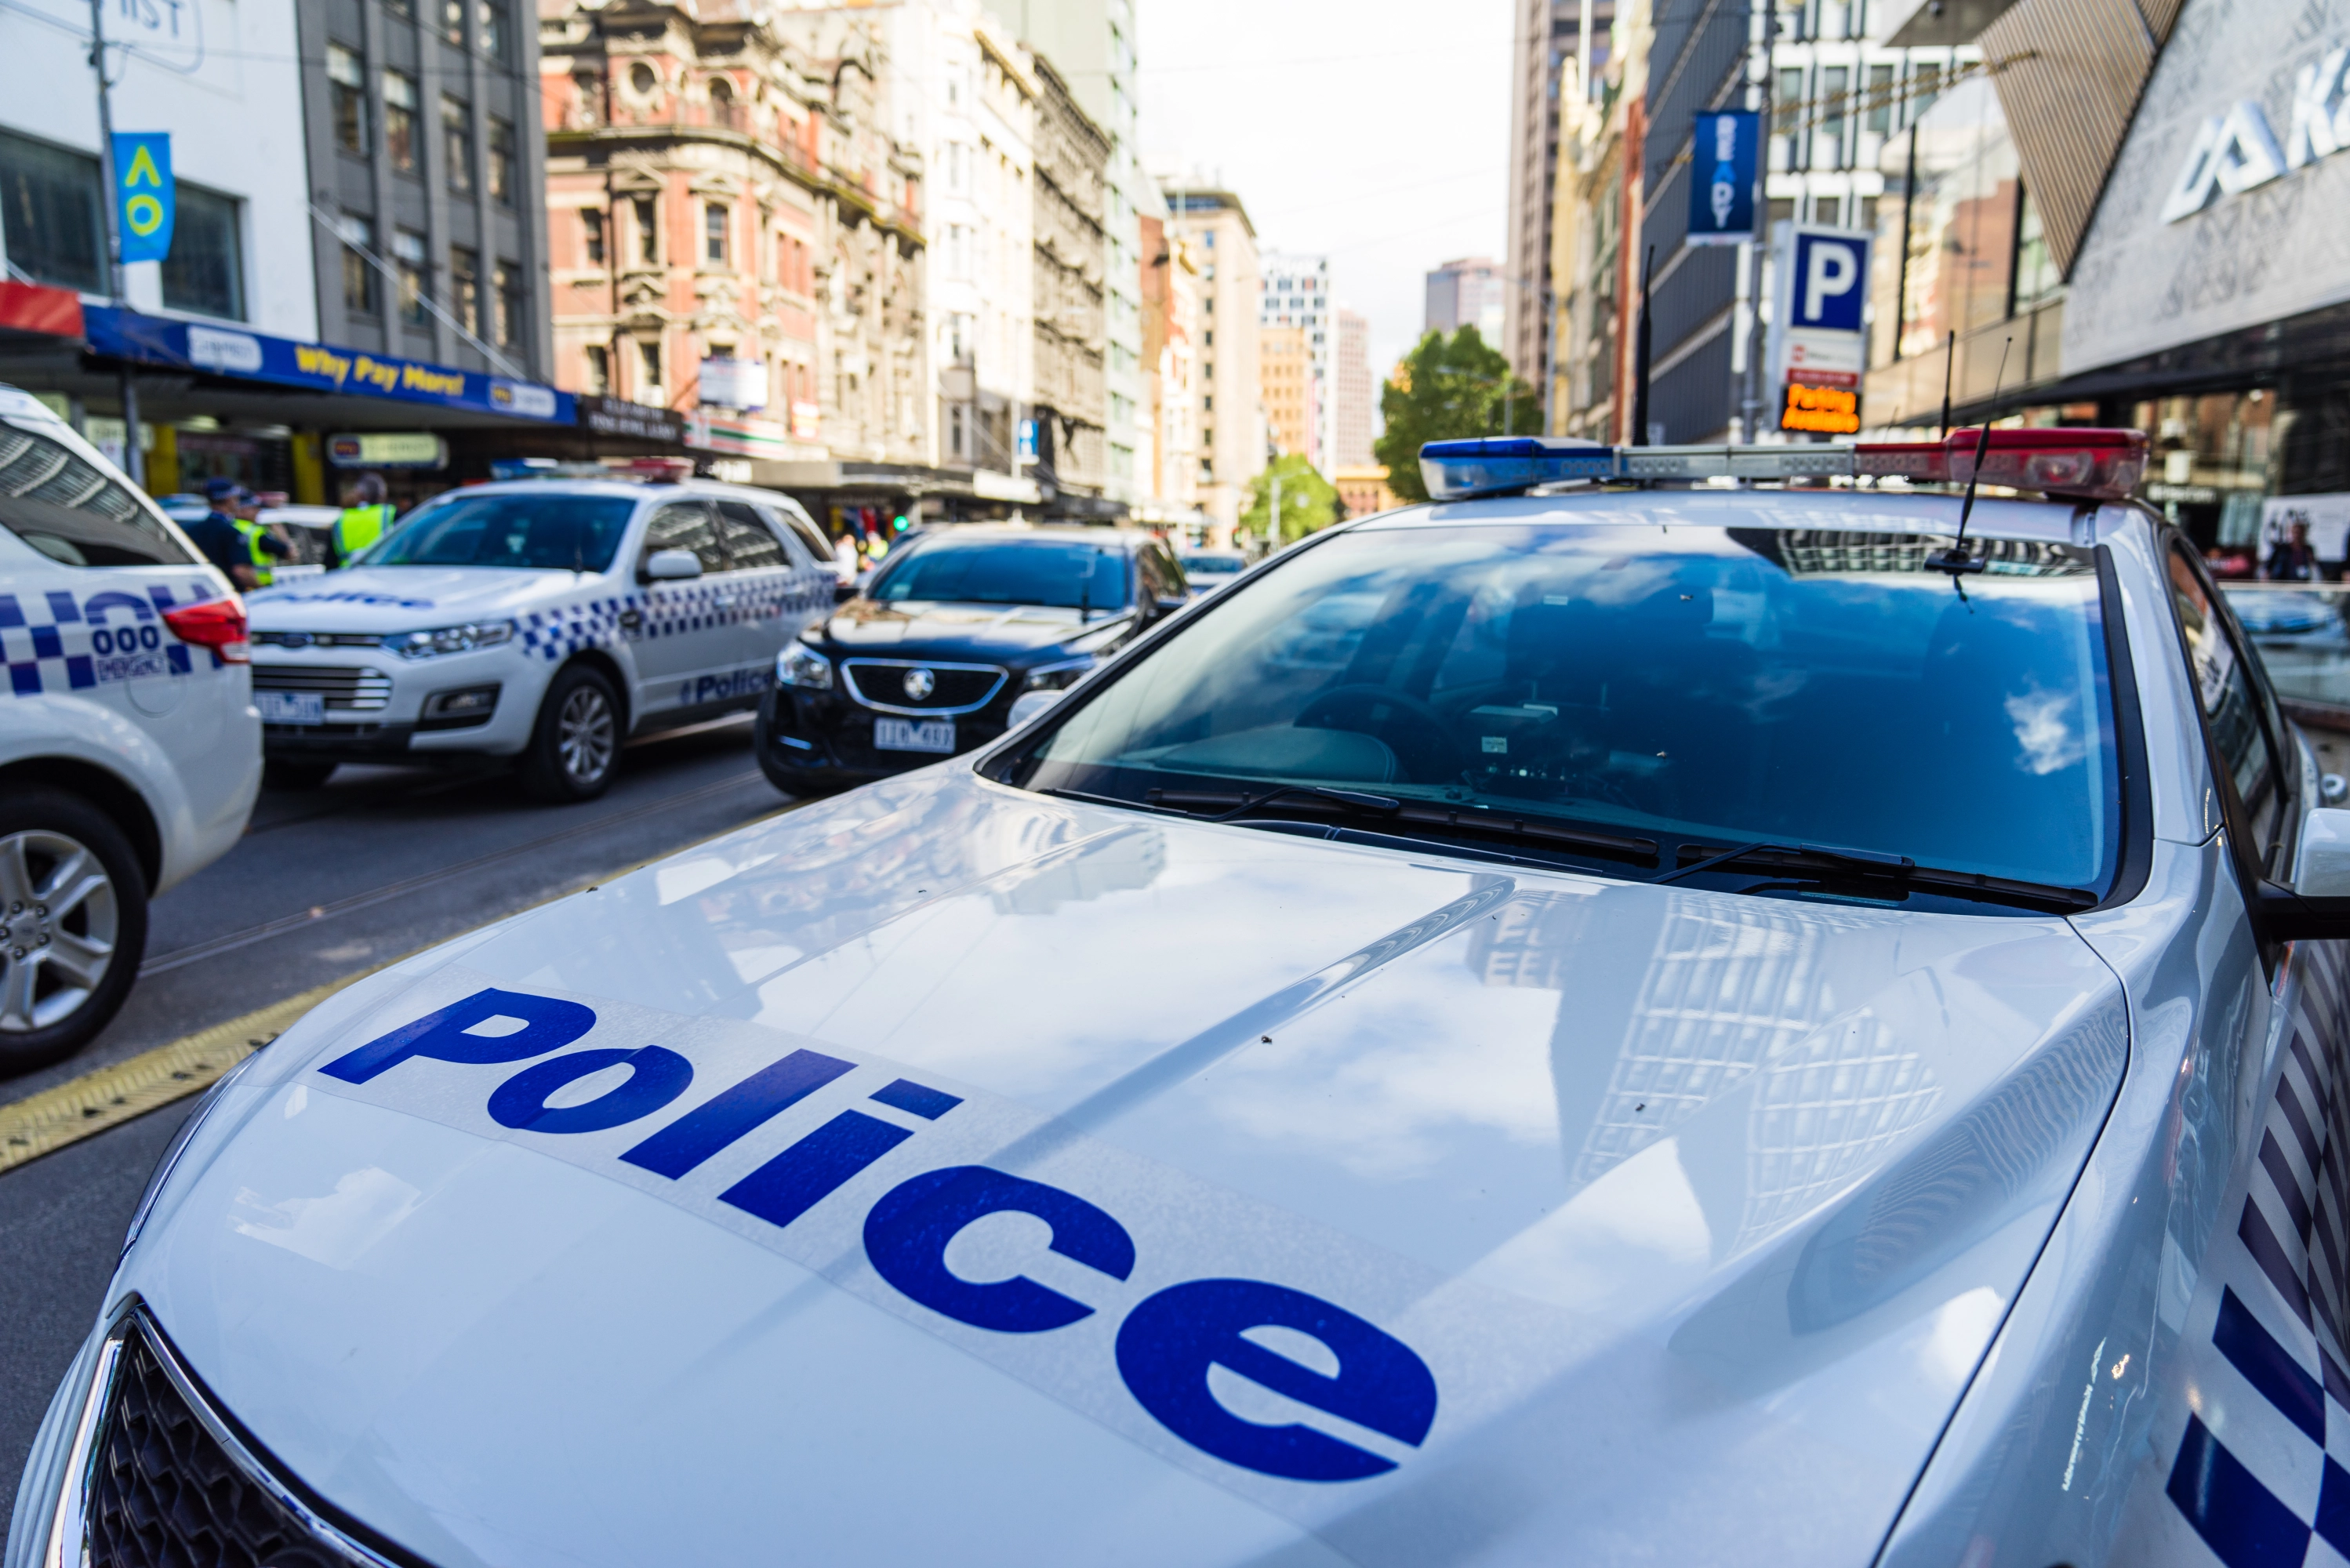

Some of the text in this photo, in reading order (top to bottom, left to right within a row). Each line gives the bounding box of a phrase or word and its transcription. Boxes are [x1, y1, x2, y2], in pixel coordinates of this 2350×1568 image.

[1711, 114, 1738, 229] READY
[1804, 241, 1858, 321] P
[294, 344, 352, 387] Why
[354, 356, 399, 393] Pay
[1788, 383, 1857, 414] Parking
[93, 626, 160, 655] 000
[320, 987, 1438, 1482] Police
